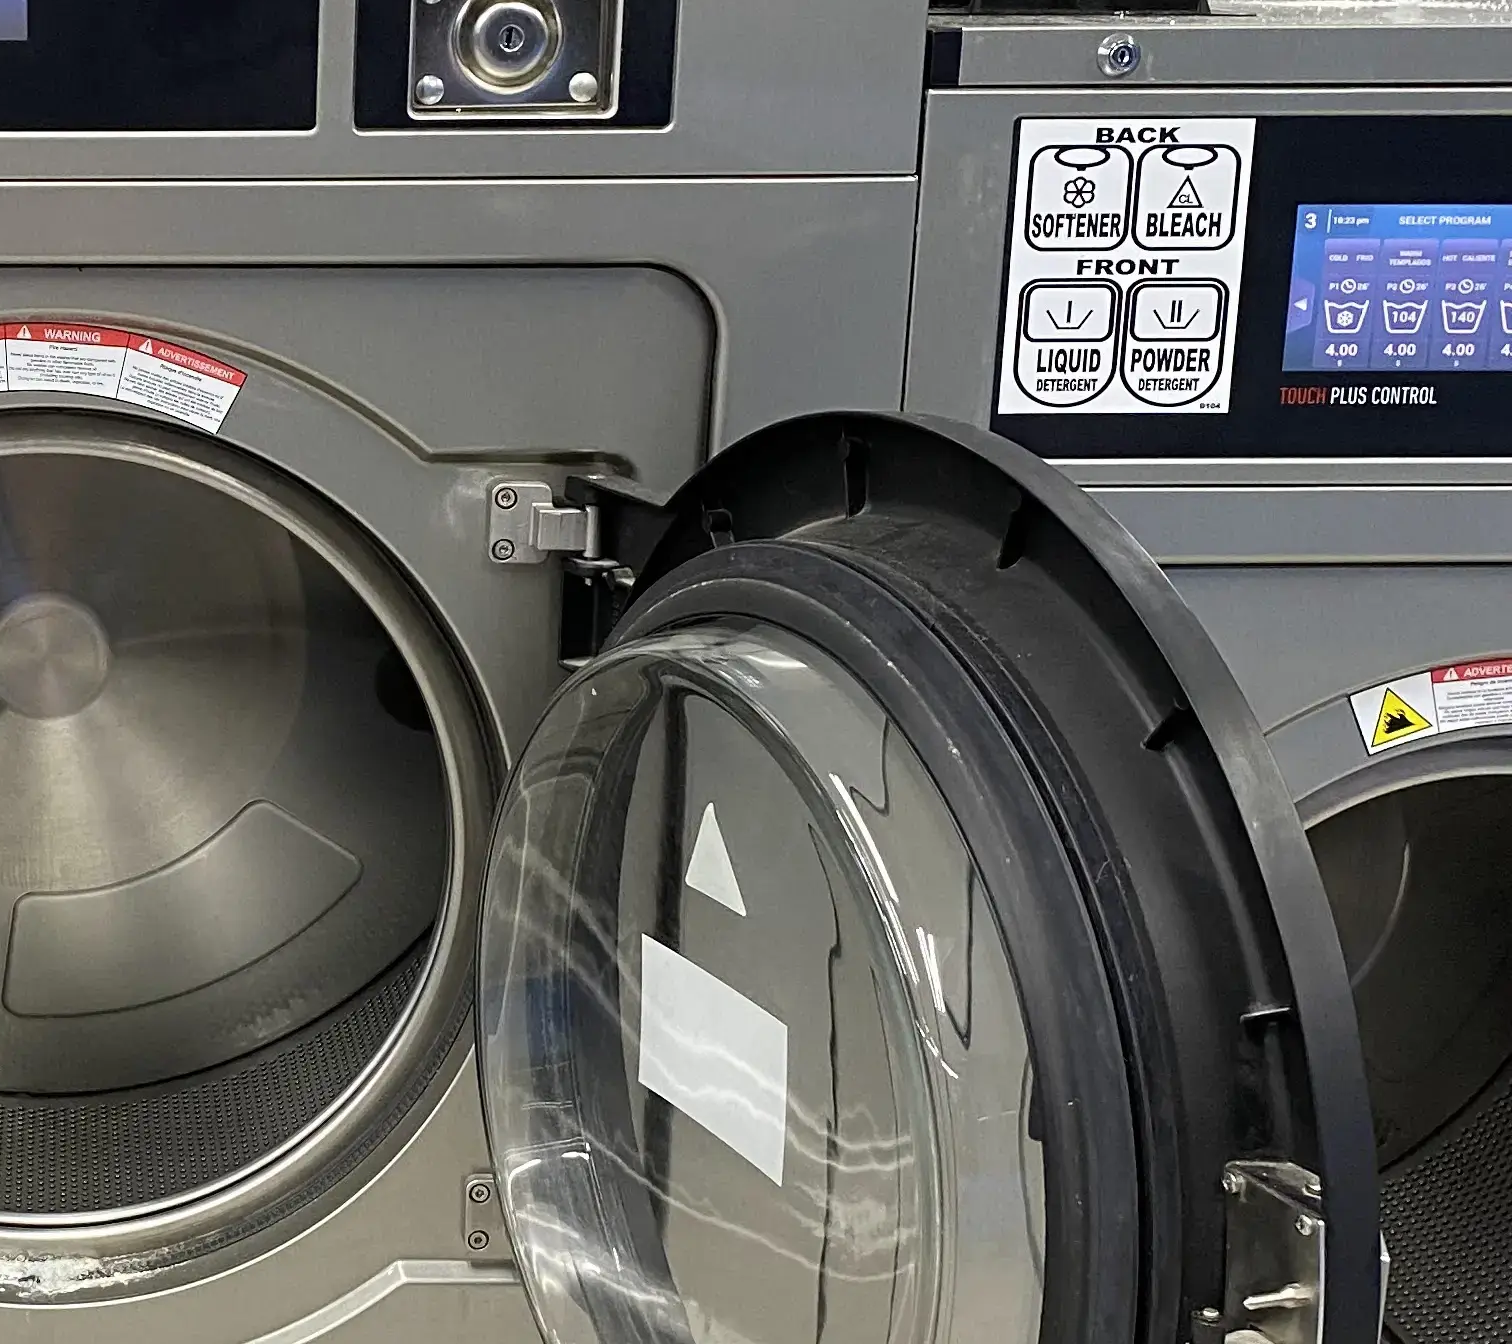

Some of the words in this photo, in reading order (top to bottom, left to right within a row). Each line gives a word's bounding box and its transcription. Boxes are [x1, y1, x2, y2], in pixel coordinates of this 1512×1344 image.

[1095, 127, 1180, 144] BACK
[1032, 213, 1121, 238] SOFTENER
[1145, 213, 1222, 237] BLEACH
[1304, 213, 1317, 229] 3
[1399, 215, 1437, 225] SELECT
[1438, 215, 1492, 225] PROGRAM
[1076, 259, 1180, 275] FRONT
[1392, 311, 1417, 324] 104
[1451, 311, 1475, 324] 140
[44, 328, 101, 343] WARNING
[1325, 343, 1358, 356] 4.00
[1384, 343, 1417, 356] 4.00
[1442, 343, 1475, 356] 4.00
[157, 347, 235, 380] ADVERTISSEMENT
[1036, 348, 1101, 374] LIQUID
[1130, 348, 1210, 372] POWDER
[1036, 378, 1098, 392] DETERGENT
[1138, 378, 1200, 391] DETERGENT
[1280, 387, 1327, 404] TOUCH
[1330, 386, 1368, 405] PLUS
[1371, 386, 1438, 405] CONTROL
